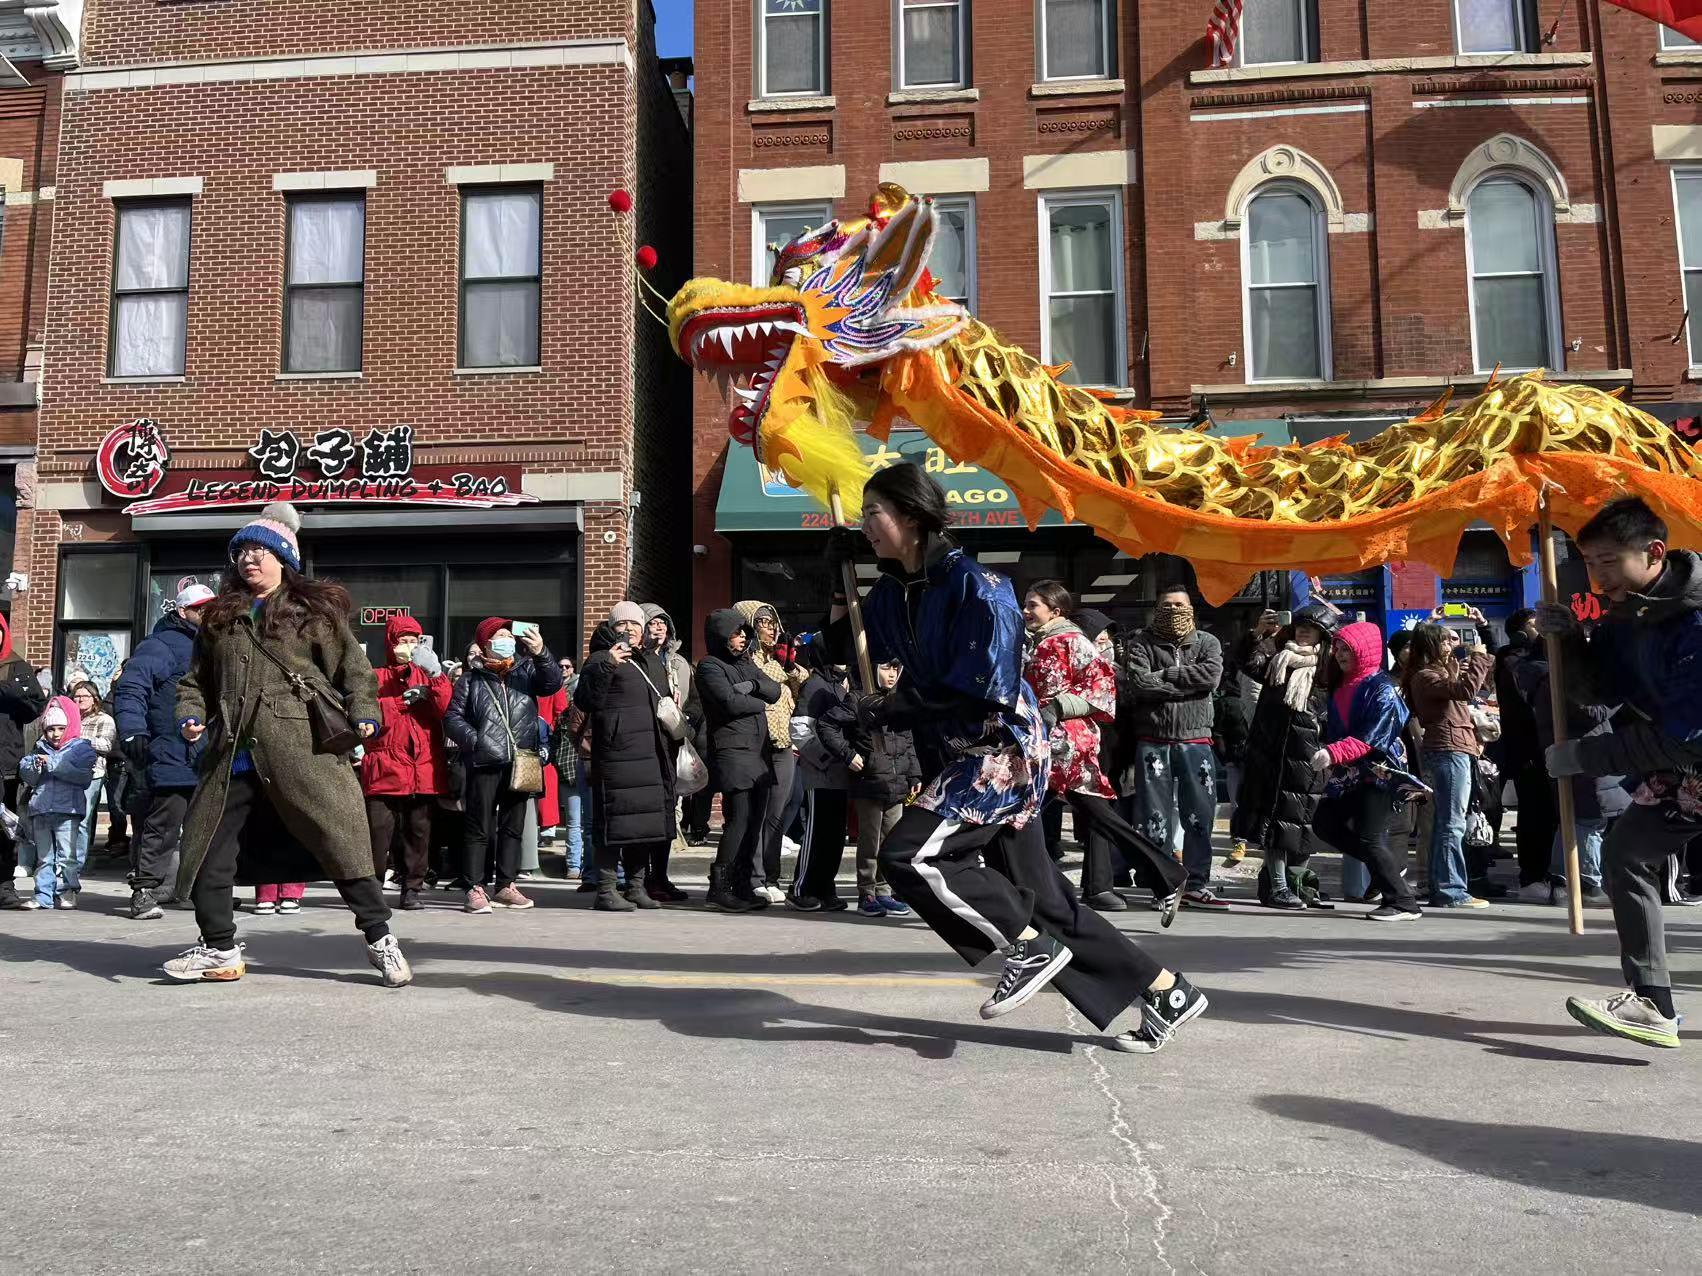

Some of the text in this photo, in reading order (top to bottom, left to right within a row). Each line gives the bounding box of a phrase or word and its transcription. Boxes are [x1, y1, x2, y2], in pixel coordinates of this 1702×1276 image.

[249, 426, 411, 478] 包子鋪
[946, 488, 1009, 505] AGO
[985, 510, 1020, 526] AVE
[363, 608, 408, 623] OPEN
